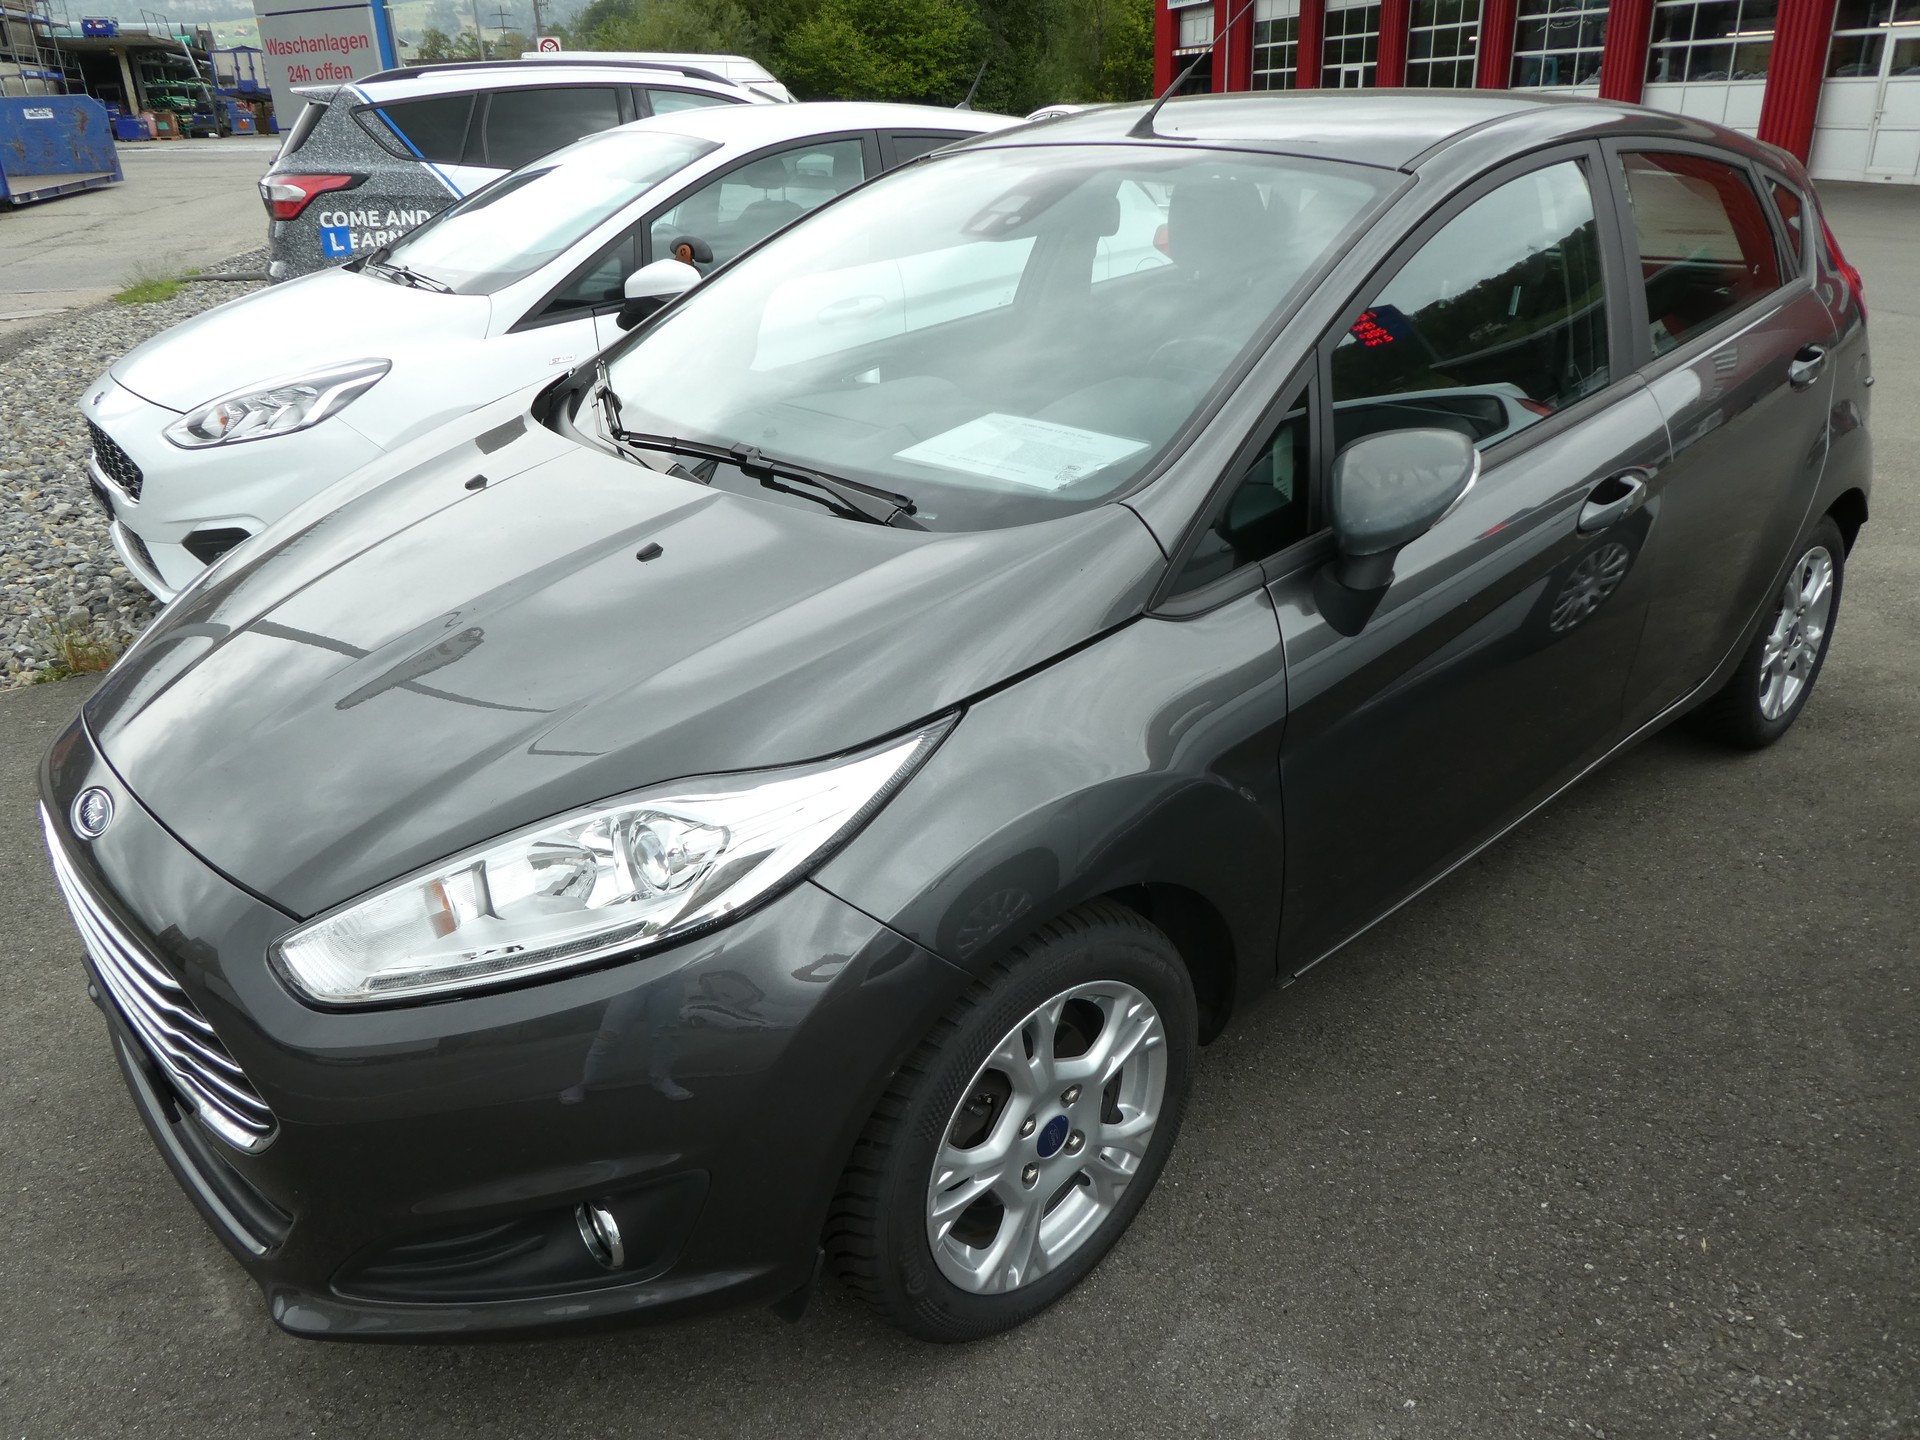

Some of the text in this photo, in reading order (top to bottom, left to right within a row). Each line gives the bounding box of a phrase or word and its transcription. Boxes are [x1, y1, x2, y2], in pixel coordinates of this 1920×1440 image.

[265, 33, 369, 55] Waschanlagen
[287, 62, 353, 82] 24h offen
[319, 210, 431, 228] COME AND
